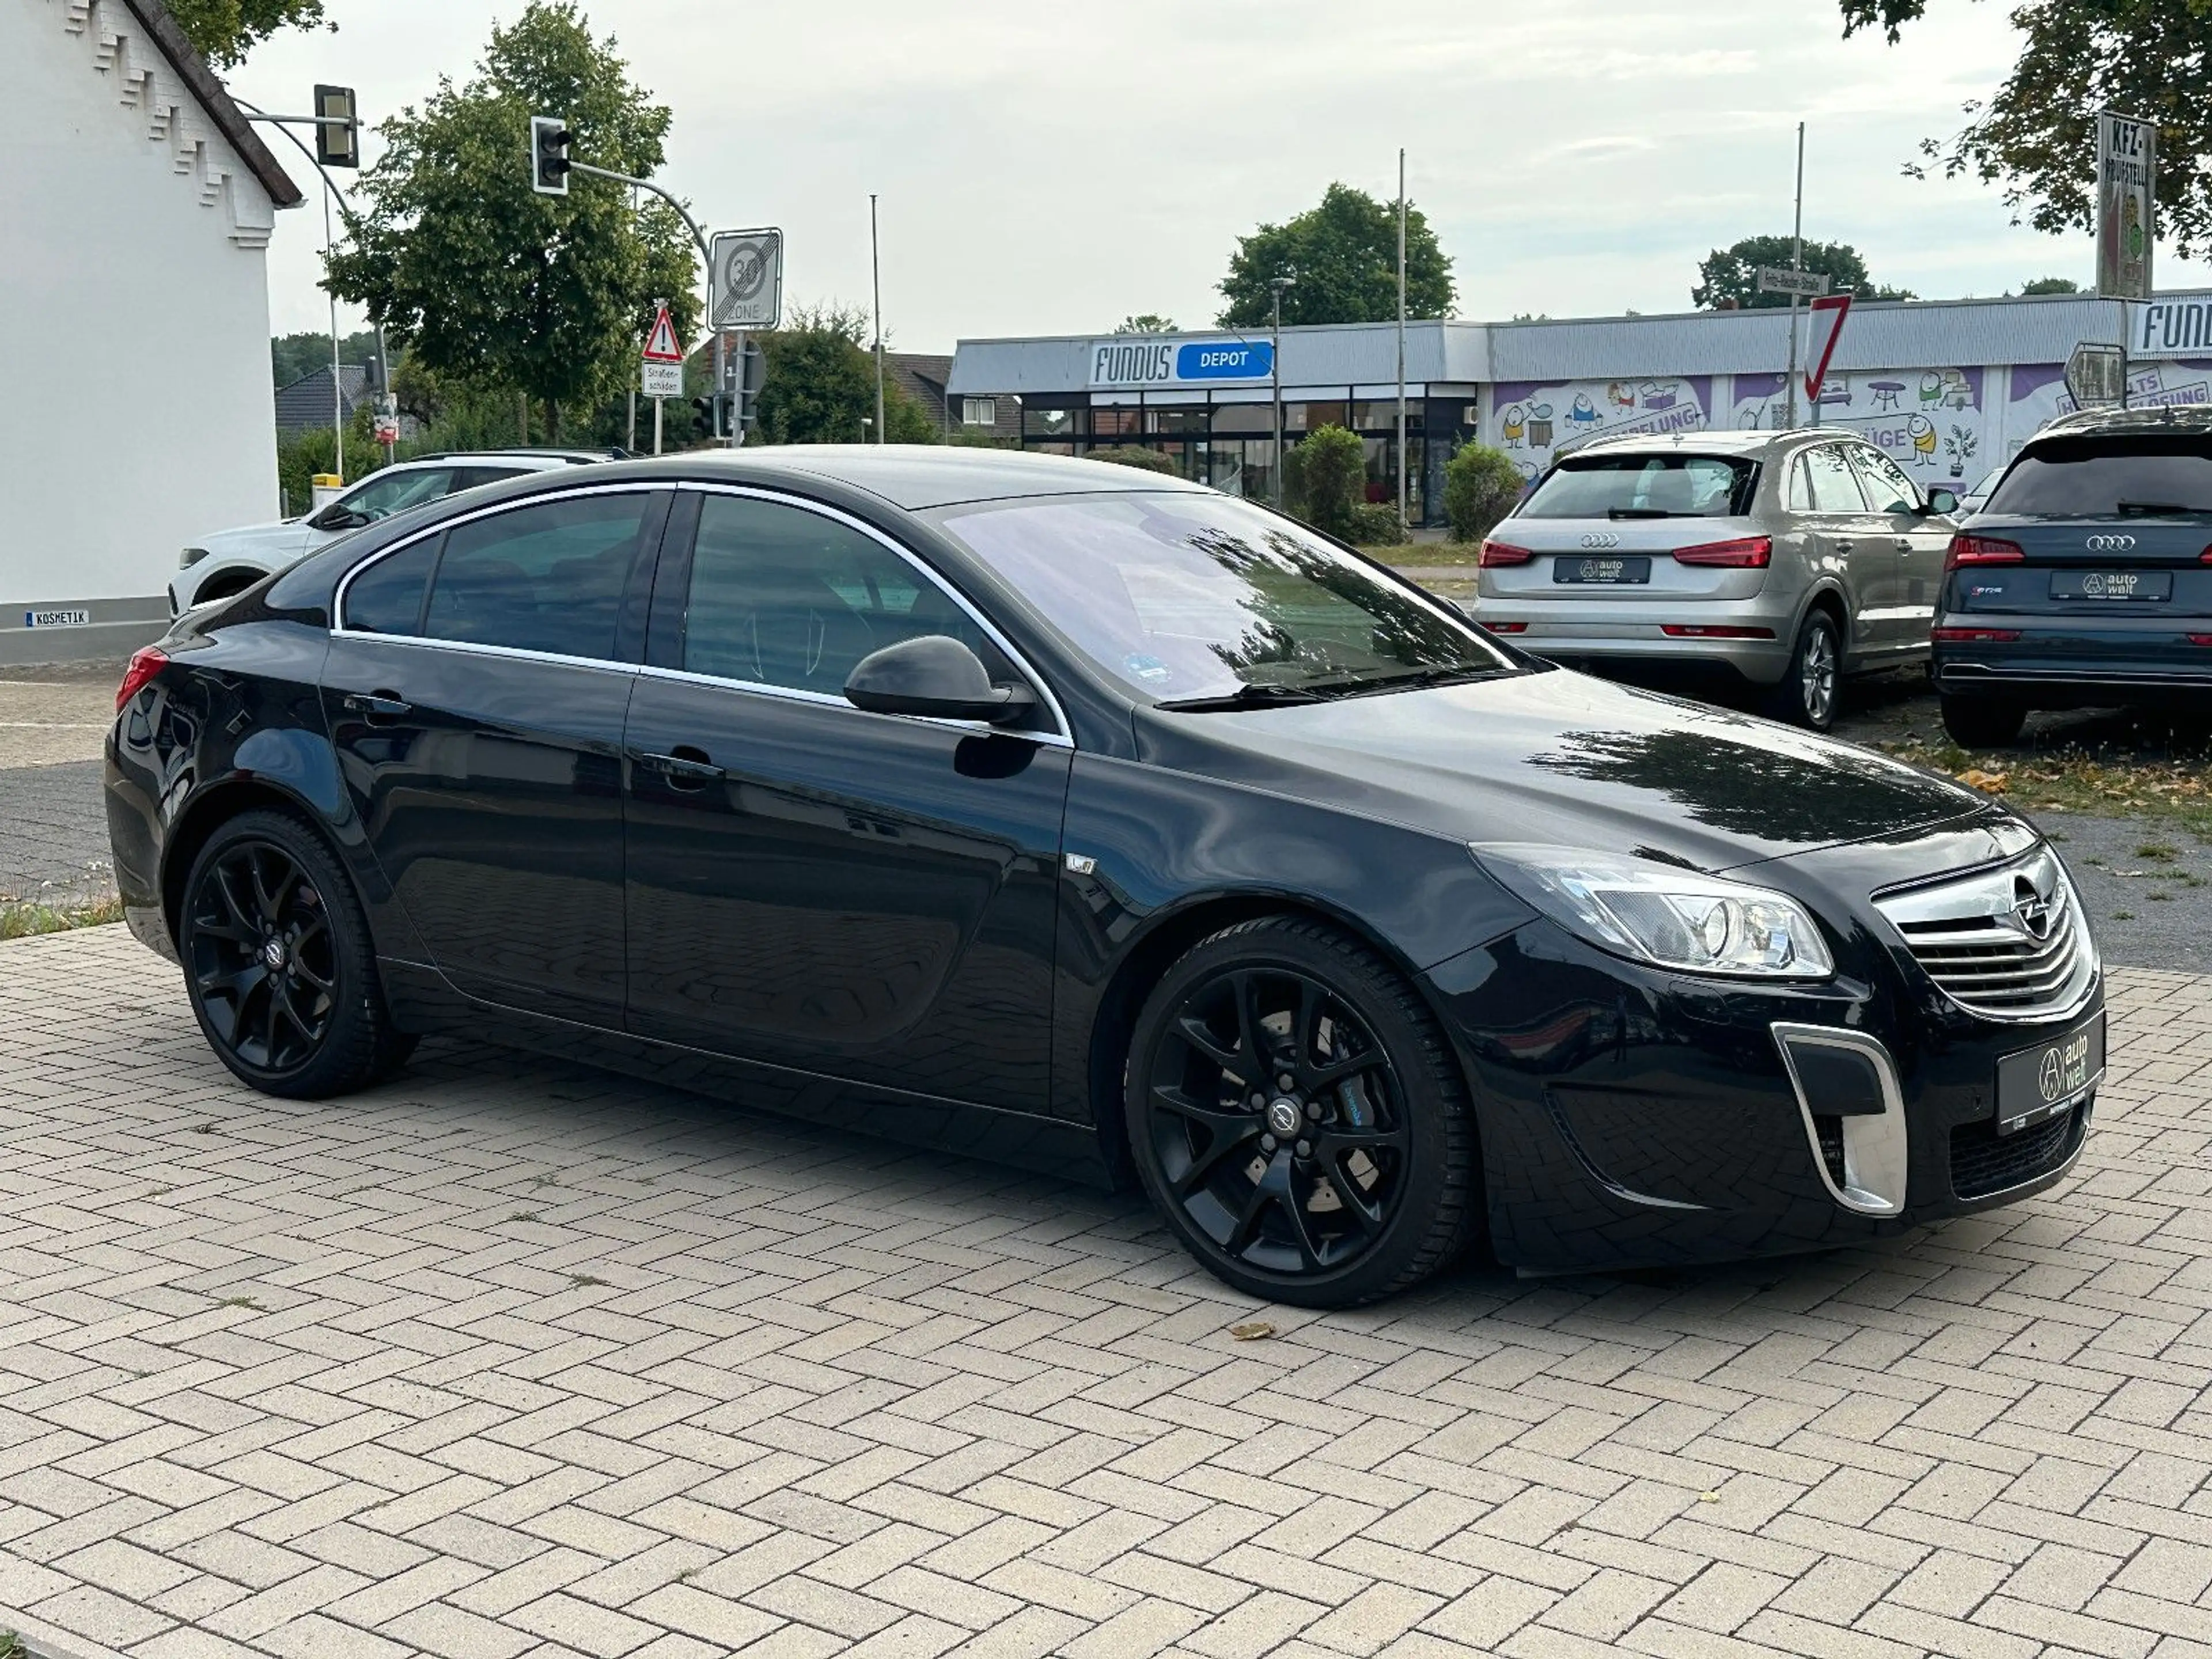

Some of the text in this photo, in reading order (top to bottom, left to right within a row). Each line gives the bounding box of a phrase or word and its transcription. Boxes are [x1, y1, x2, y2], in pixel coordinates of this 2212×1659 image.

[2112, 120, 2142, 157] KFZ-
[733, 257, 760, 287] 30
[1095, 346, 1249, 382] FUNDUS DEPOT
[1599, 560, 1623, 569] auto
[2108, 575, 2138, 585] auto
[2108, 584, 2133, 594] welt
[36, 612, 85, 624] KOSMETIK
[2065, 1034, 2088, 1066] auto
